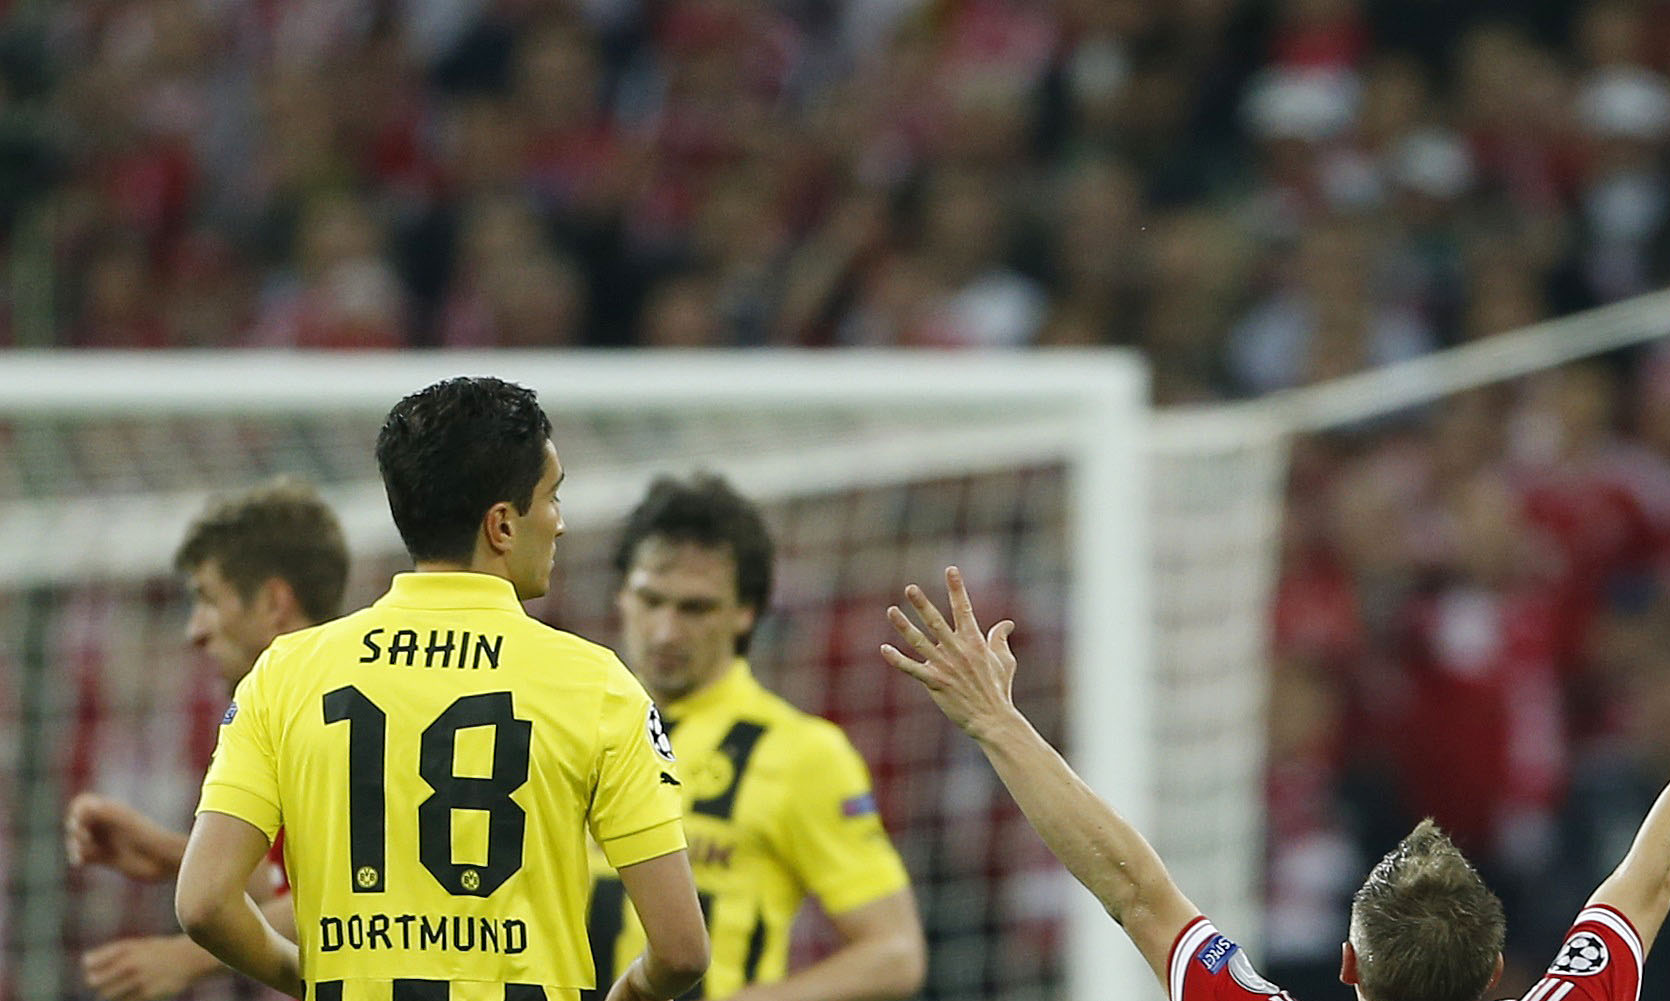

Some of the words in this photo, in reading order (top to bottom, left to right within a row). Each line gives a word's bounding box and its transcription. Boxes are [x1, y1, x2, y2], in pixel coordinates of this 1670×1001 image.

[359, 627, 504, 670] SAHIN
[321, 684, 533, 899] 18
[319, 913, 529, 955] DORTMUND
[1201, 937, 1236, 970] SPECT
